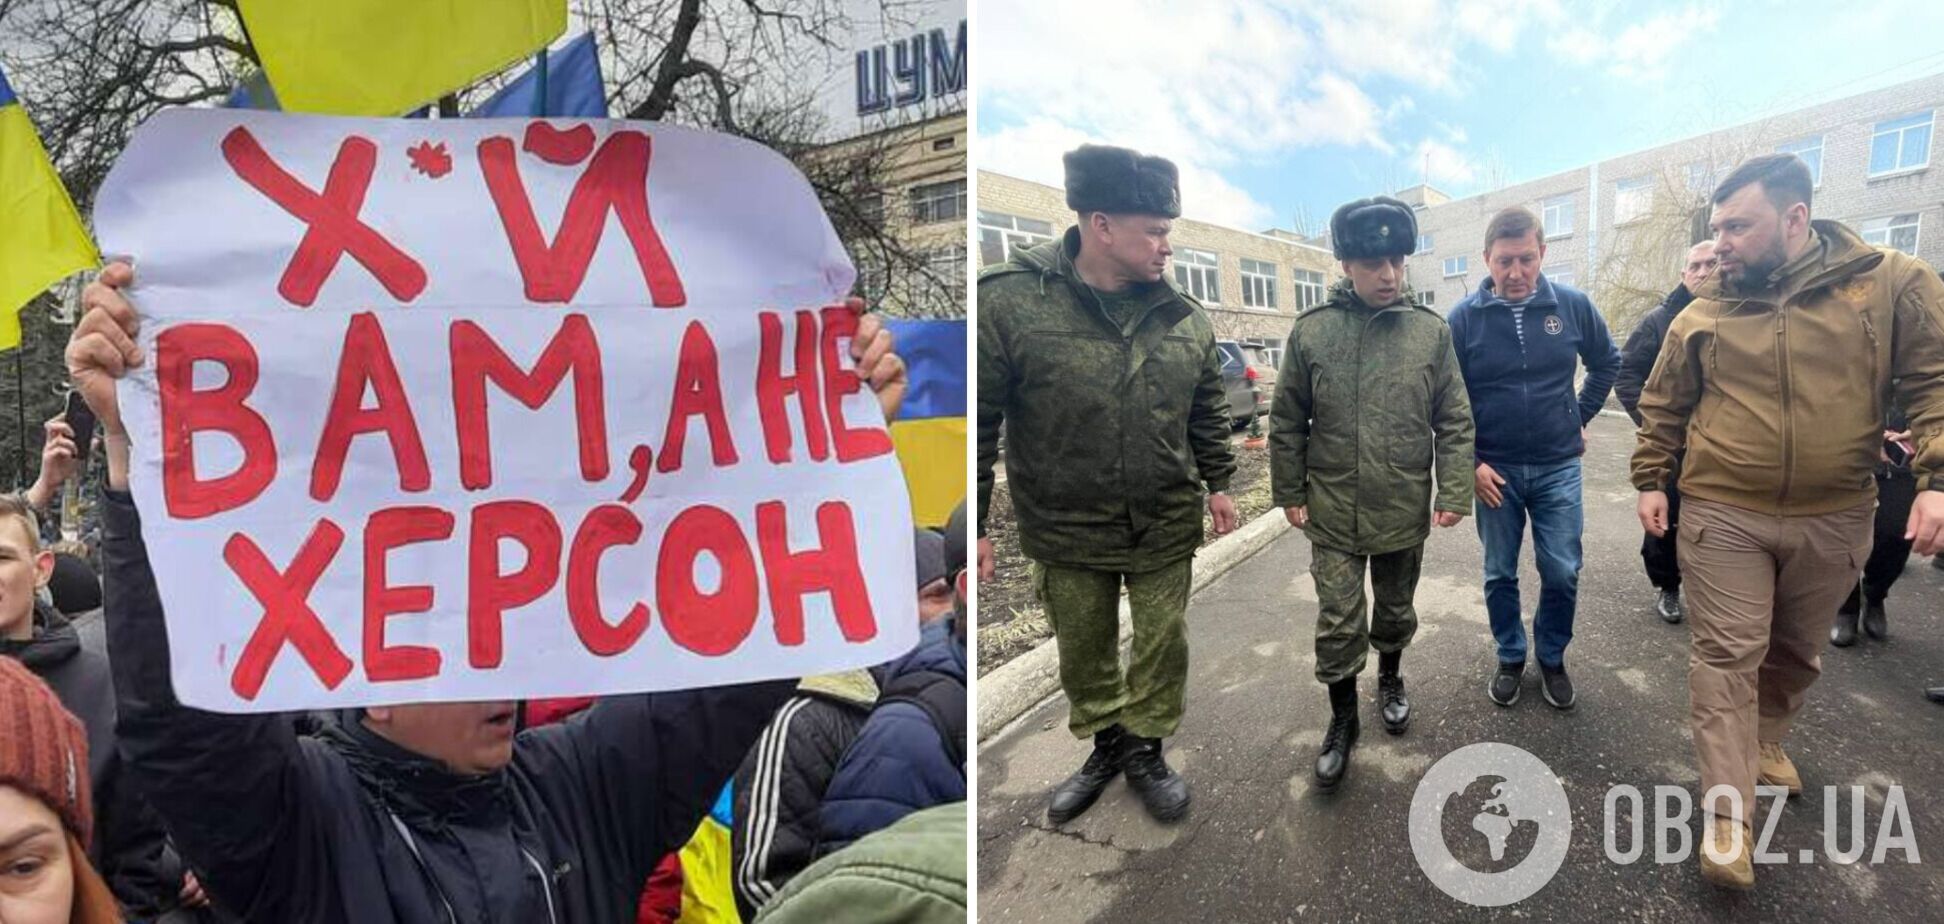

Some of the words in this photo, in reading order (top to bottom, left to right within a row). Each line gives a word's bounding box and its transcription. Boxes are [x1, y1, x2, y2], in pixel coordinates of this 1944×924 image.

[856, 19, 967, 117] ЦУМ
[756, 307, 894, 465] НЕ
[222, 499, 878, 702] ХЕРСОН
